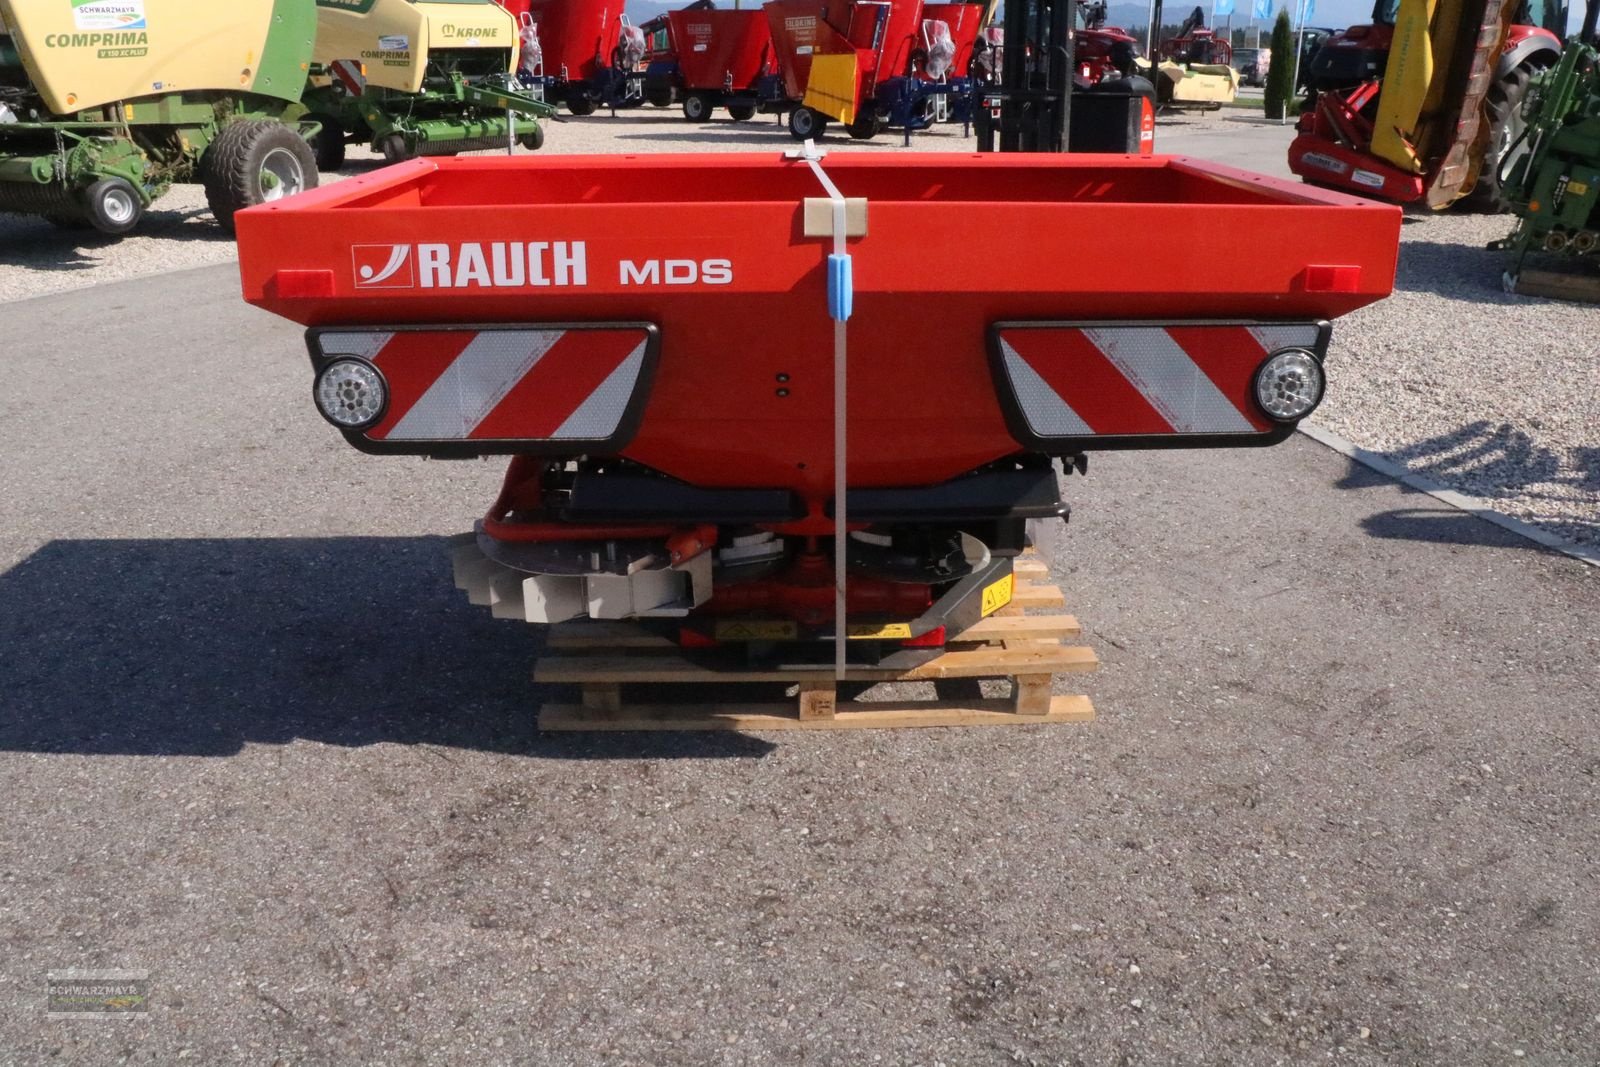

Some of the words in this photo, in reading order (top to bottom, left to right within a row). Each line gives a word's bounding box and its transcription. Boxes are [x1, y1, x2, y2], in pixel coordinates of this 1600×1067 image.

[79, 6, 135, 14] SCHWARZMAYR
[456, 27, 498, 38] KRONE
[45, 31, 148, 48] COMPRIMA
[360, 50, 410, 60] COMPRIMA
[417, 241, 588, 289] RAUCH
[619, 258, 733, 285] MDS
